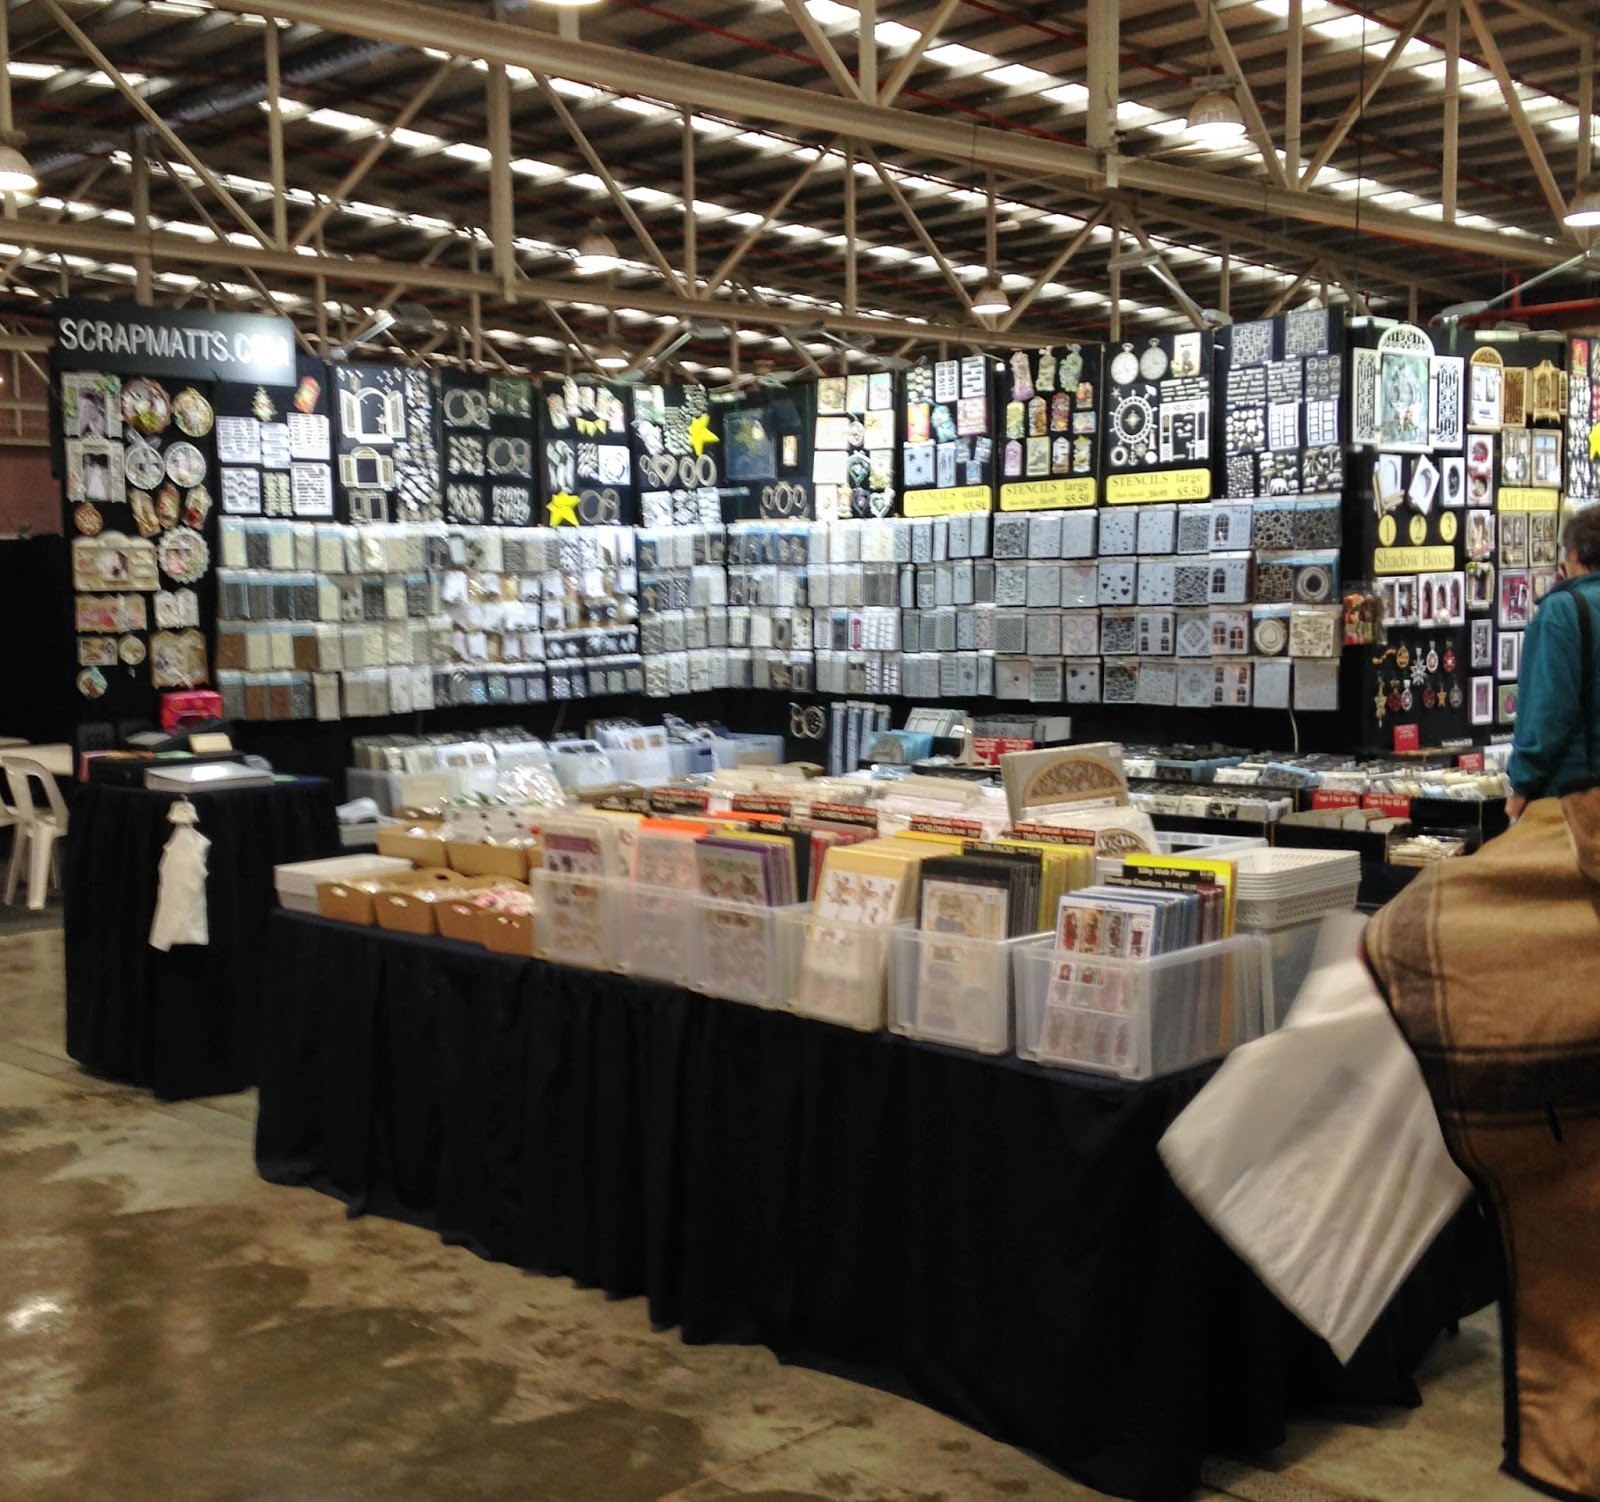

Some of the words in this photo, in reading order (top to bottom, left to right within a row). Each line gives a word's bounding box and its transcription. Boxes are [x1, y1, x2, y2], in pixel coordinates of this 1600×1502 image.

[1112, 474, 1168, 487] STENCILS
[1175, 473, 1202, 484] large
[961, 488, 985, 499] small
[1006, 482, 1057, 495] STENCILS
[1063, 480, 1088, 492] large
[1177, 485, 1203, 497] $5.50
[1065, 493, 1089, 505] $5.50
[1501, 493, 1517, 507] Art
[1522, 493, 1557, 508] Frames
[1376, 551, 1419, 569] Shadow
[1424, 549, 1453, 567] Boxes
[1170, 868, 1190, 878] Paper
